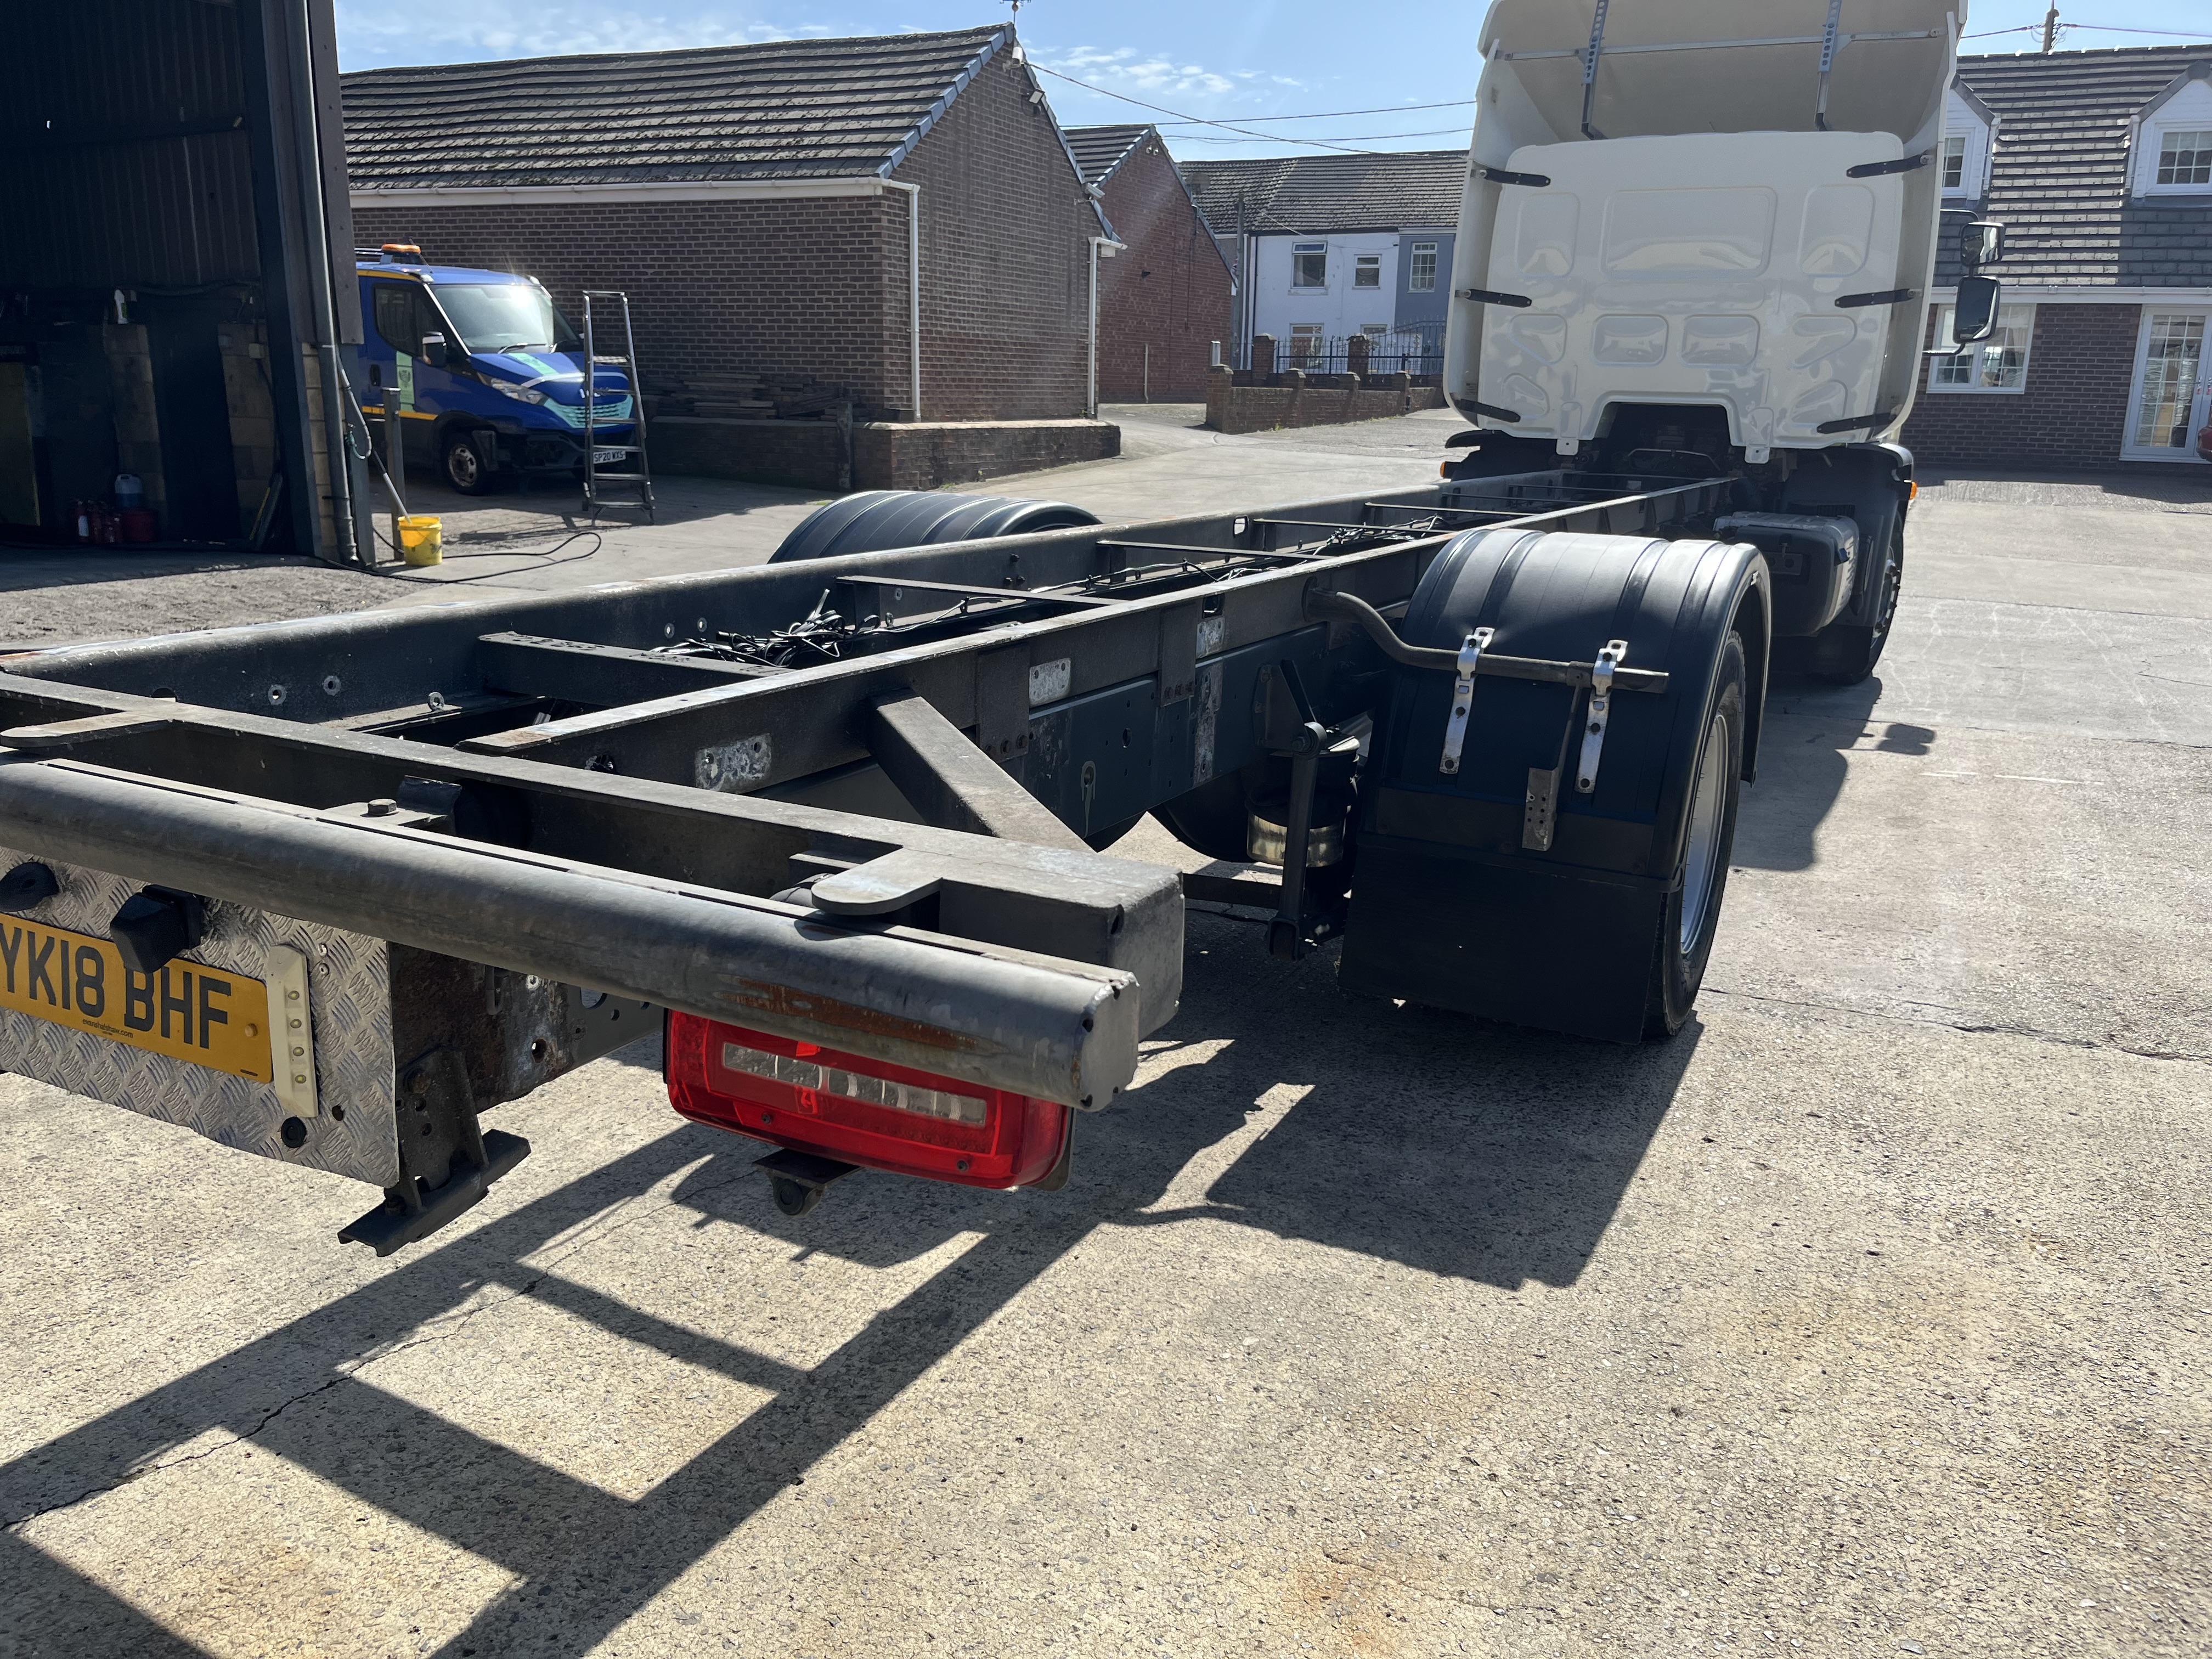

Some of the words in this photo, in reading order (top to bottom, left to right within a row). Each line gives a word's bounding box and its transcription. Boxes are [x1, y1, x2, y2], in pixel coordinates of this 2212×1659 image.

[594, 452, 611, 462] SP20
[0, 922, 105, 1018] YK18
[124, 964, 232, 1050] BHF
